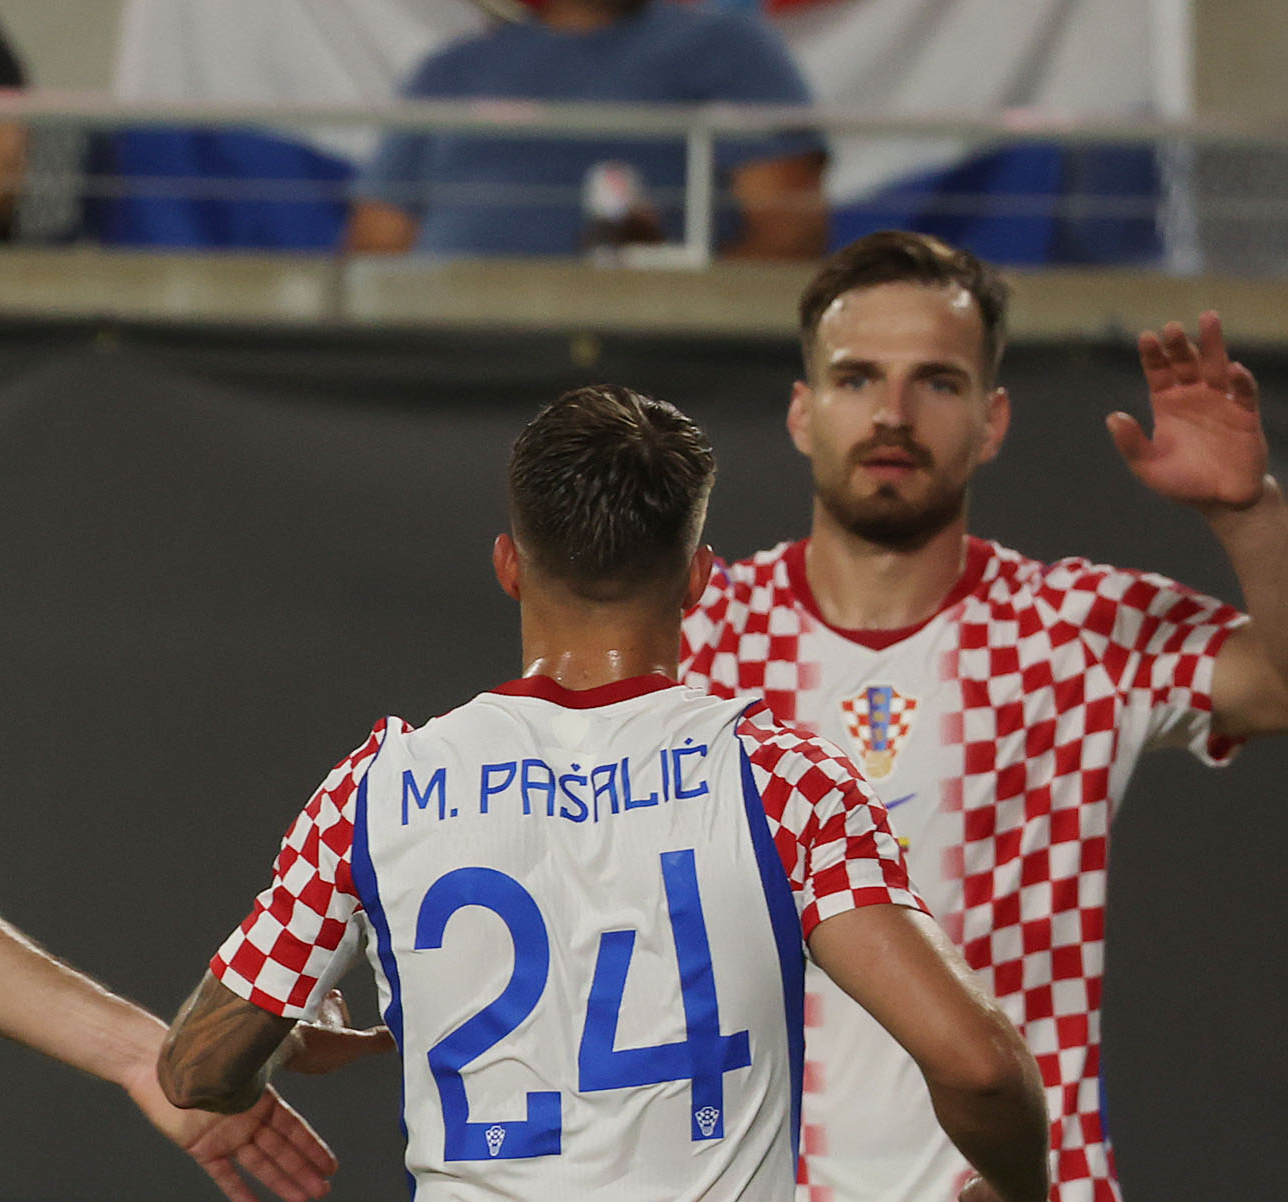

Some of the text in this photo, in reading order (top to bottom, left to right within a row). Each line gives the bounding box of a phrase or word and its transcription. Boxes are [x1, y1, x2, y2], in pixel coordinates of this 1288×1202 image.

[401, 737, 710, 826] M. PAŠALIĆ
[414, 848, 752, 1162] 24
